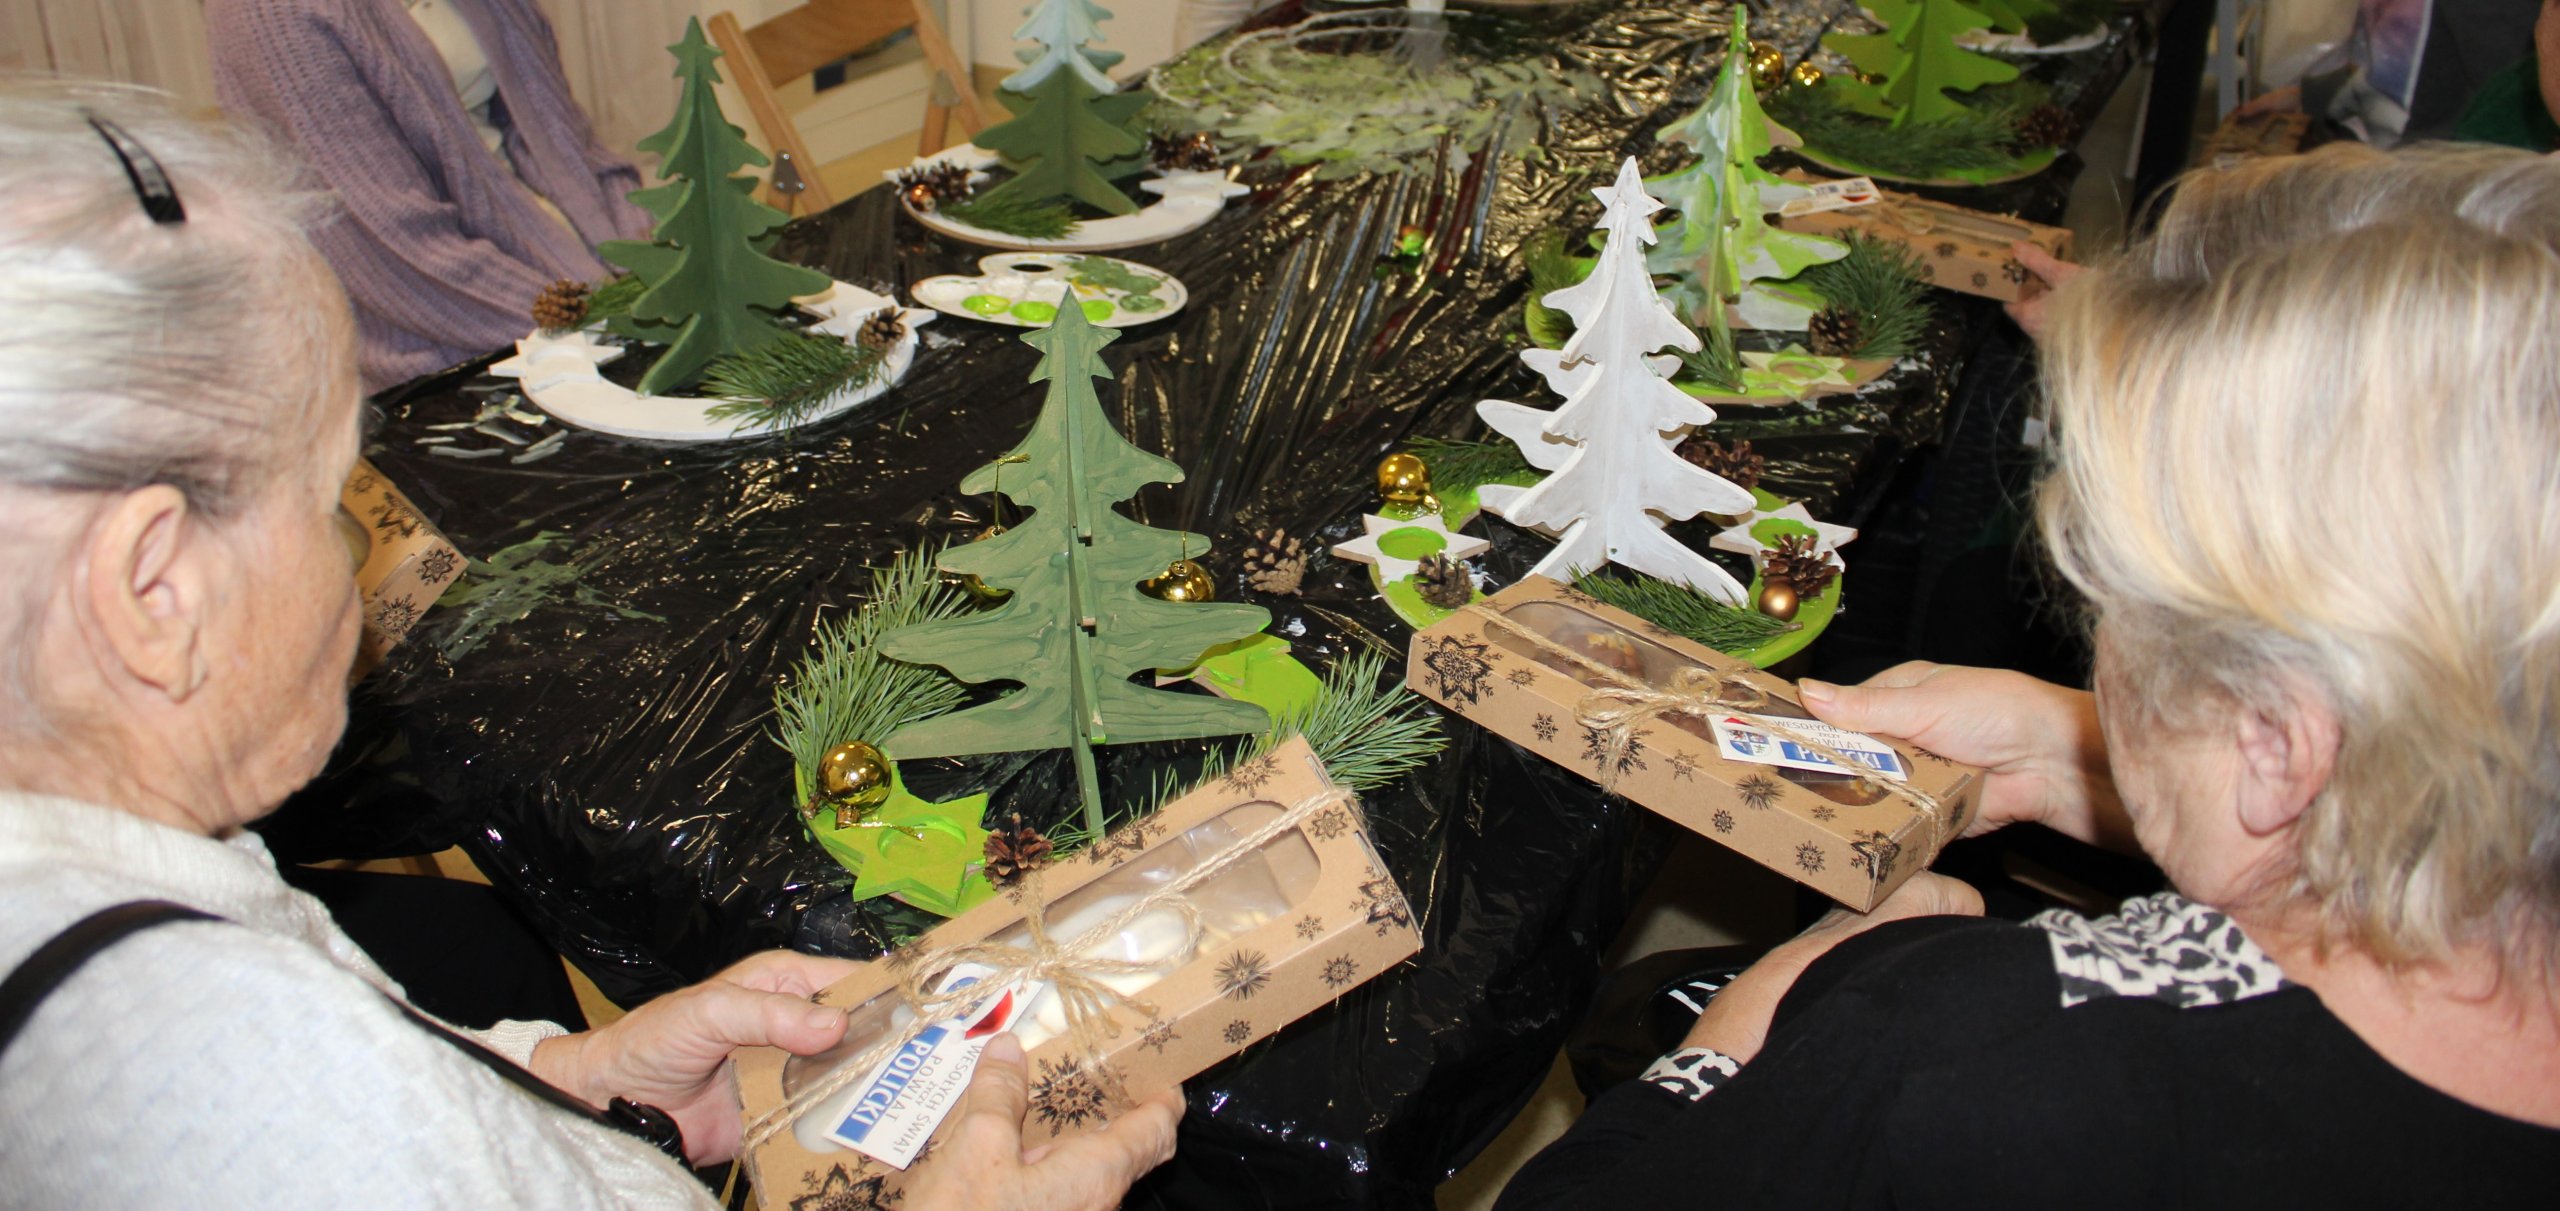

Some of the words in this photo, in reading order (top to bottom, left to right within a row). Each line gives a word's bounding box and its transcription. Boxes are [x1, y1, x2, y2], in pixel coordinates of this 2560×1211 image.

[1811, 737, 1863, 750] OWIAT
[851, 1039, 933, 1126] POLICKI
[885, 1055, 943, 1122] POWIAT
[925, 1044, 984, 1111] WESOŁYCH
[892, 1114, 933, 1154] ŚWIĄT
